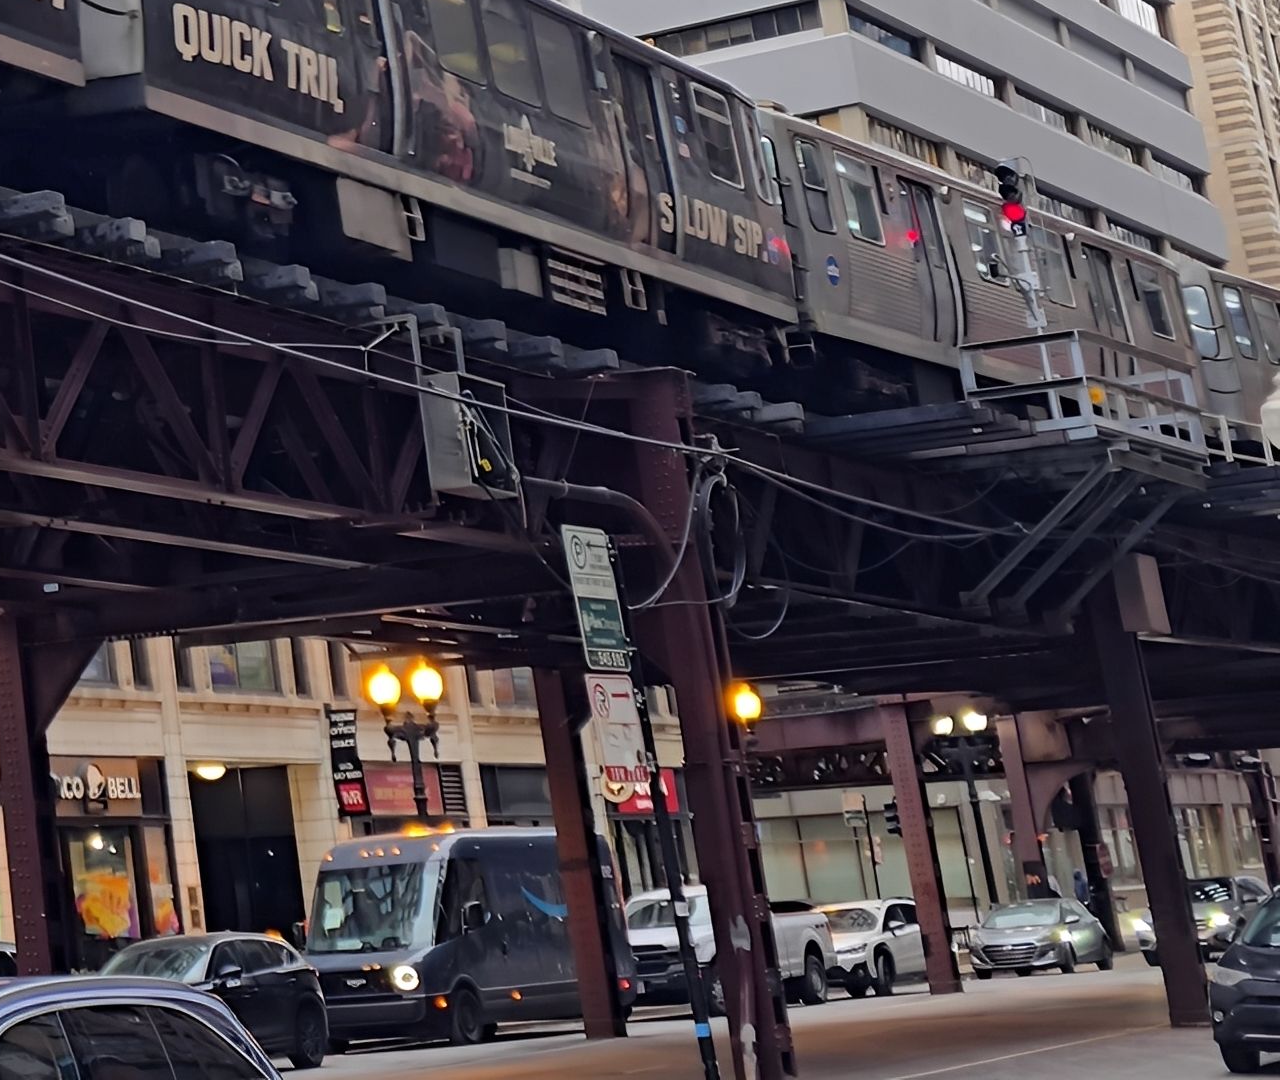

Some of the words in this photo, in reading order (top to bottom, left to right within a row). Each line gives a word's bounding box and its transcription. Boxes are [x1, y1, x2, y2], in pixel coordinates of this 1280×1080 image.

[172, 2, 274, 82] QUICK
[59, 775, 85, 799] CO
[107, 776, 142, 799] BELL
